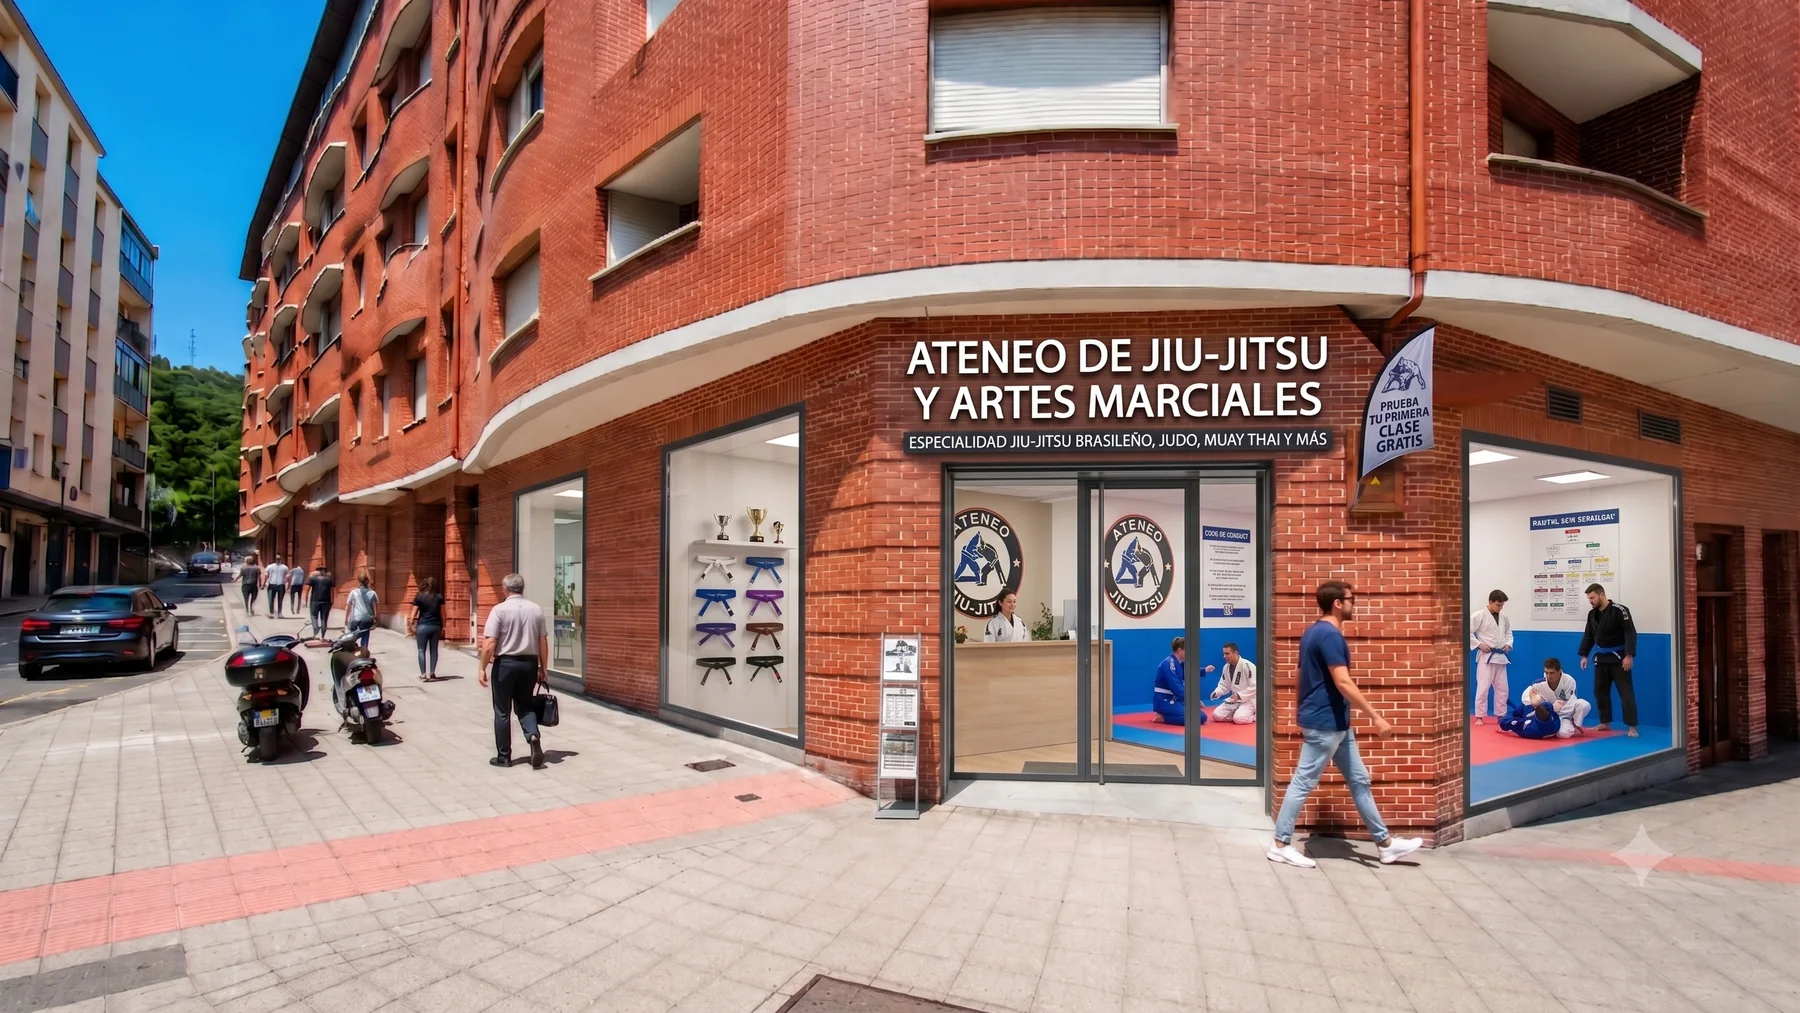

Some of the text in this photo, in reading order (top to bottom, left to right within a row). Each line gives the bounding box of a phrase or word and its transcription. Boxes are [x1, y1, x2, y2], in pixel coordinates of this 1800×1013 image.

[906, 335, 1328, 375] ATENEO DE JIU-JITSU
[913, 381, 1322, 420] Y ARTES MARCIALES
[1380, 397, 1419, 412] PRUEBA
[1369, 406, 1430, 425] TU PRIMERA
[909, 430, 1328, 449] ESPECIALIDAD JIU-JITSU BRASILEÑO, JUDO, MUAY THAI Y MÁS
[1379, 420, 1420, 438] CLASE
[1376, 434, 1423, 453] GRATIS
[954, 512, 1010, 538] ATENEO
[1112, 519, 1163, 542] ATENEO
[954, 589, 998, 616] IU-JIT
[1109, 591, 1164, 615] JIU-JITSU
